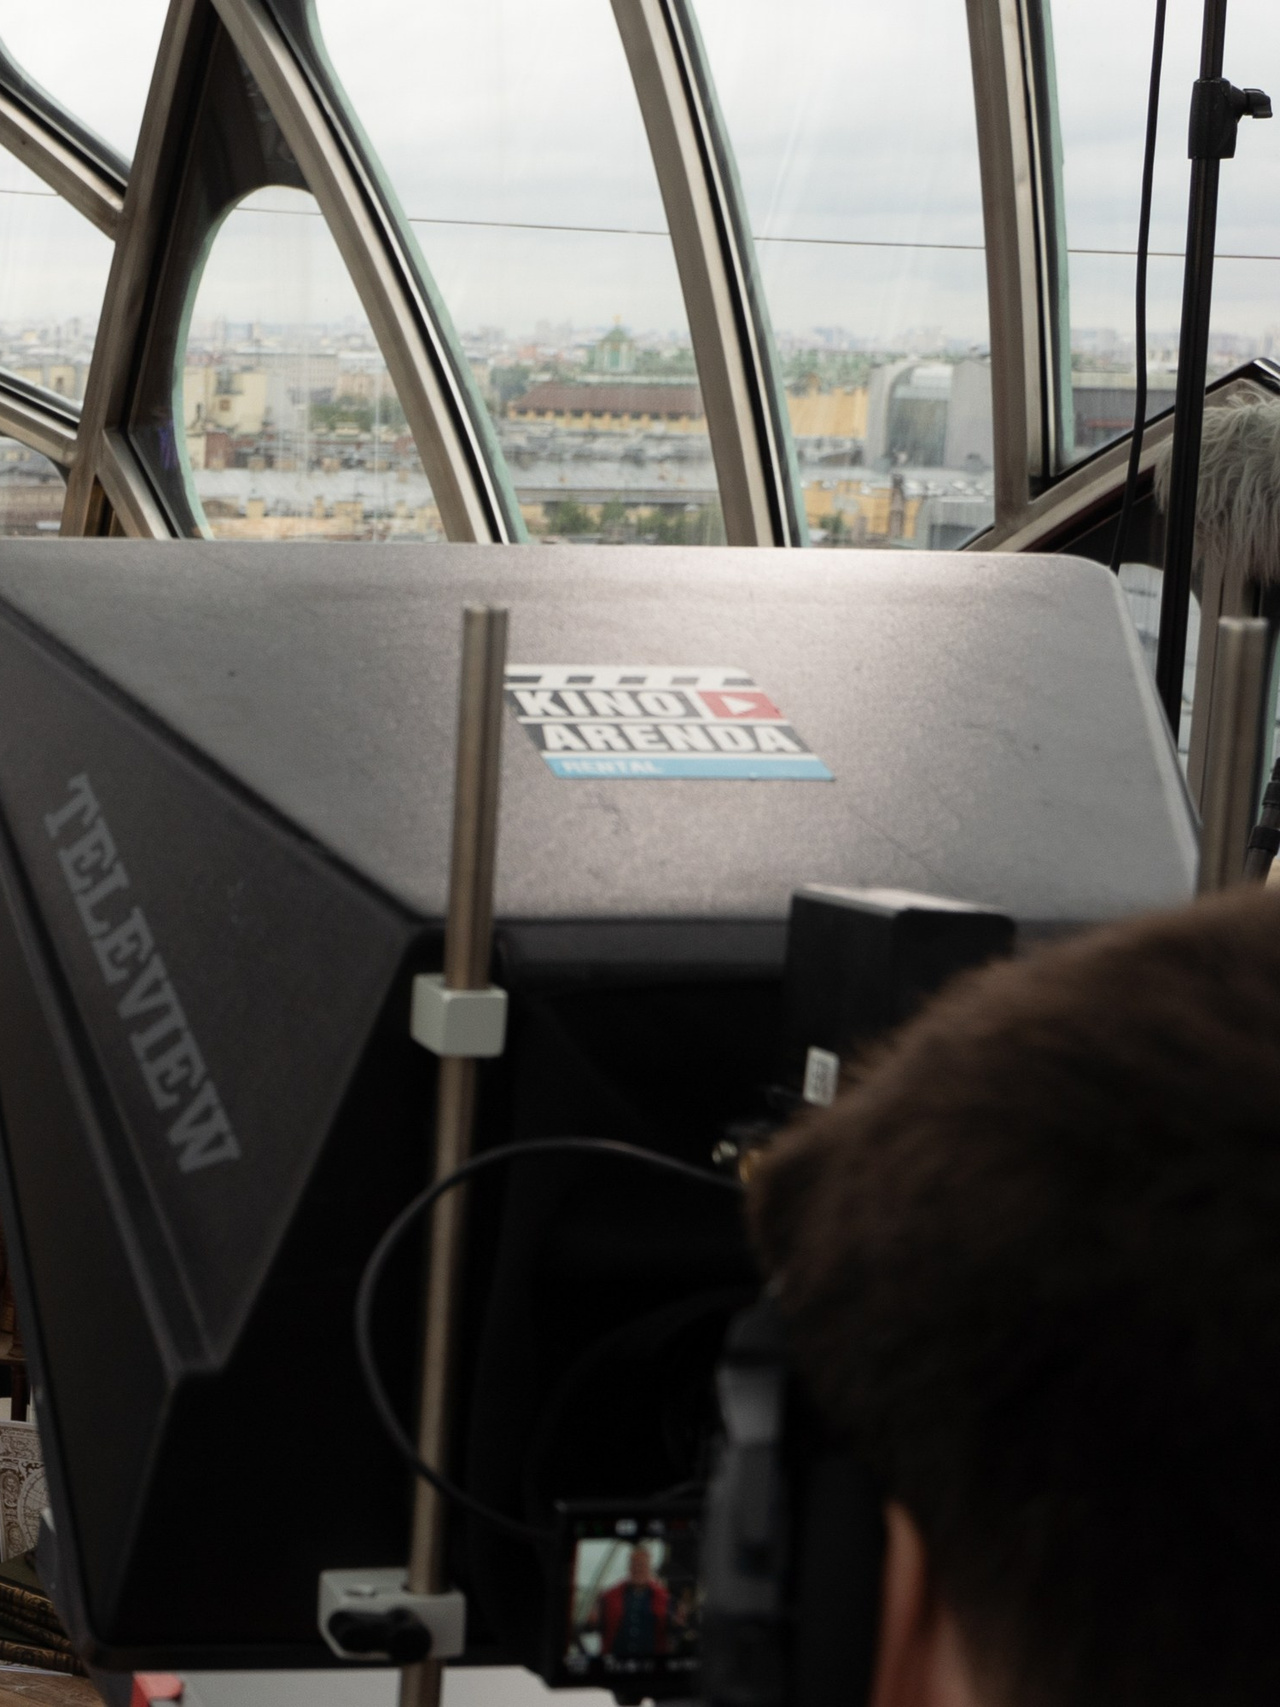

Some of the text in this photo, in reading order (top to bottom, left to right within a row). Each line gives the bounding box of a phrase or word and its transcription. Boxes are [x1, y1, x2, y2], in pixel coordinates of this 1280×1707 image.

[514, 690, 687, 718] KINO
[541, 723, 804, 752] ARENDA
[43, 772, 241, 1174] TELEVIEW
